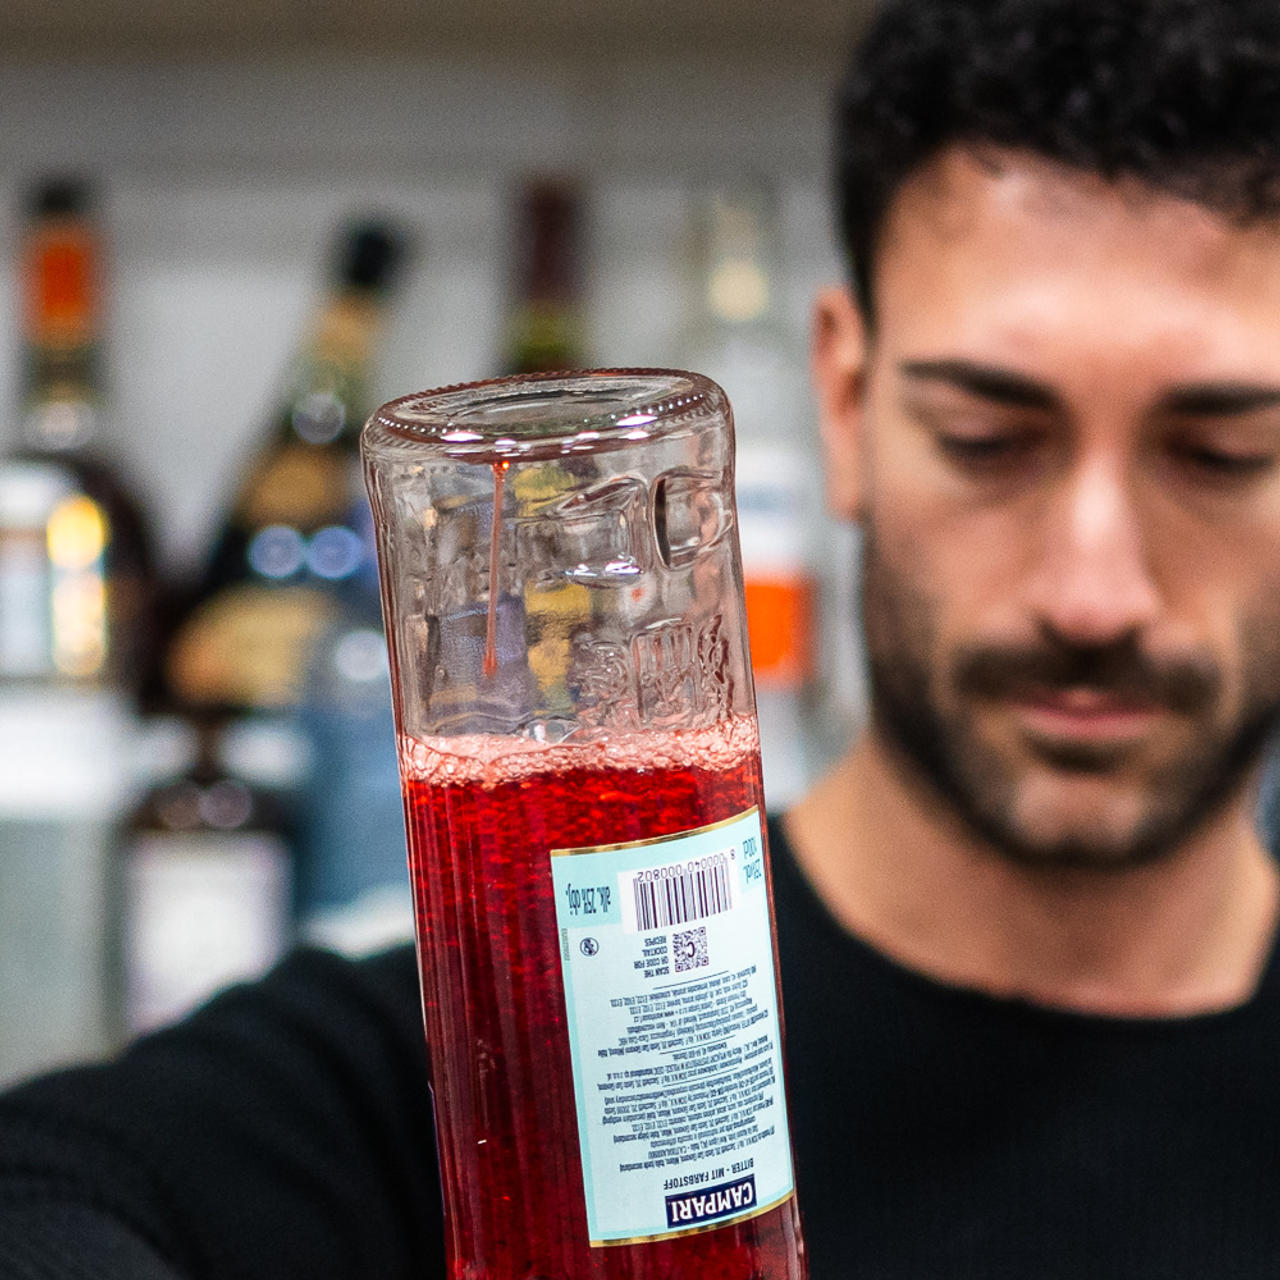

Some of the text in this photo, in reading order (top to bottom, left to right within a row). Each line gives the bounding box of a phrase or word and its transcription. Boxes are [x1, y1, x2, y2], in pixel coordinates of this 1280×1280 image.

[636, 863, 682, 883] 000802
[564, 884, 581, 914] obj.
[596, 885, 612, 913] alk.
[644, 935, 667, 947] RECIPES
[642, 945, 668, 958] COCKTAIL
[633, 959, 645, 969] FOR
[645, 957, 660, 967] CODE
[643, 966, 670, 978] SCAN THE
[711, 1167, 724, 1179] MIT
[731, 1158, 754, 1174] BITTER
[662, 1171, 709, 1190] FARBSTOFF
[669, 1180, 753, 1223] CAMPARI
